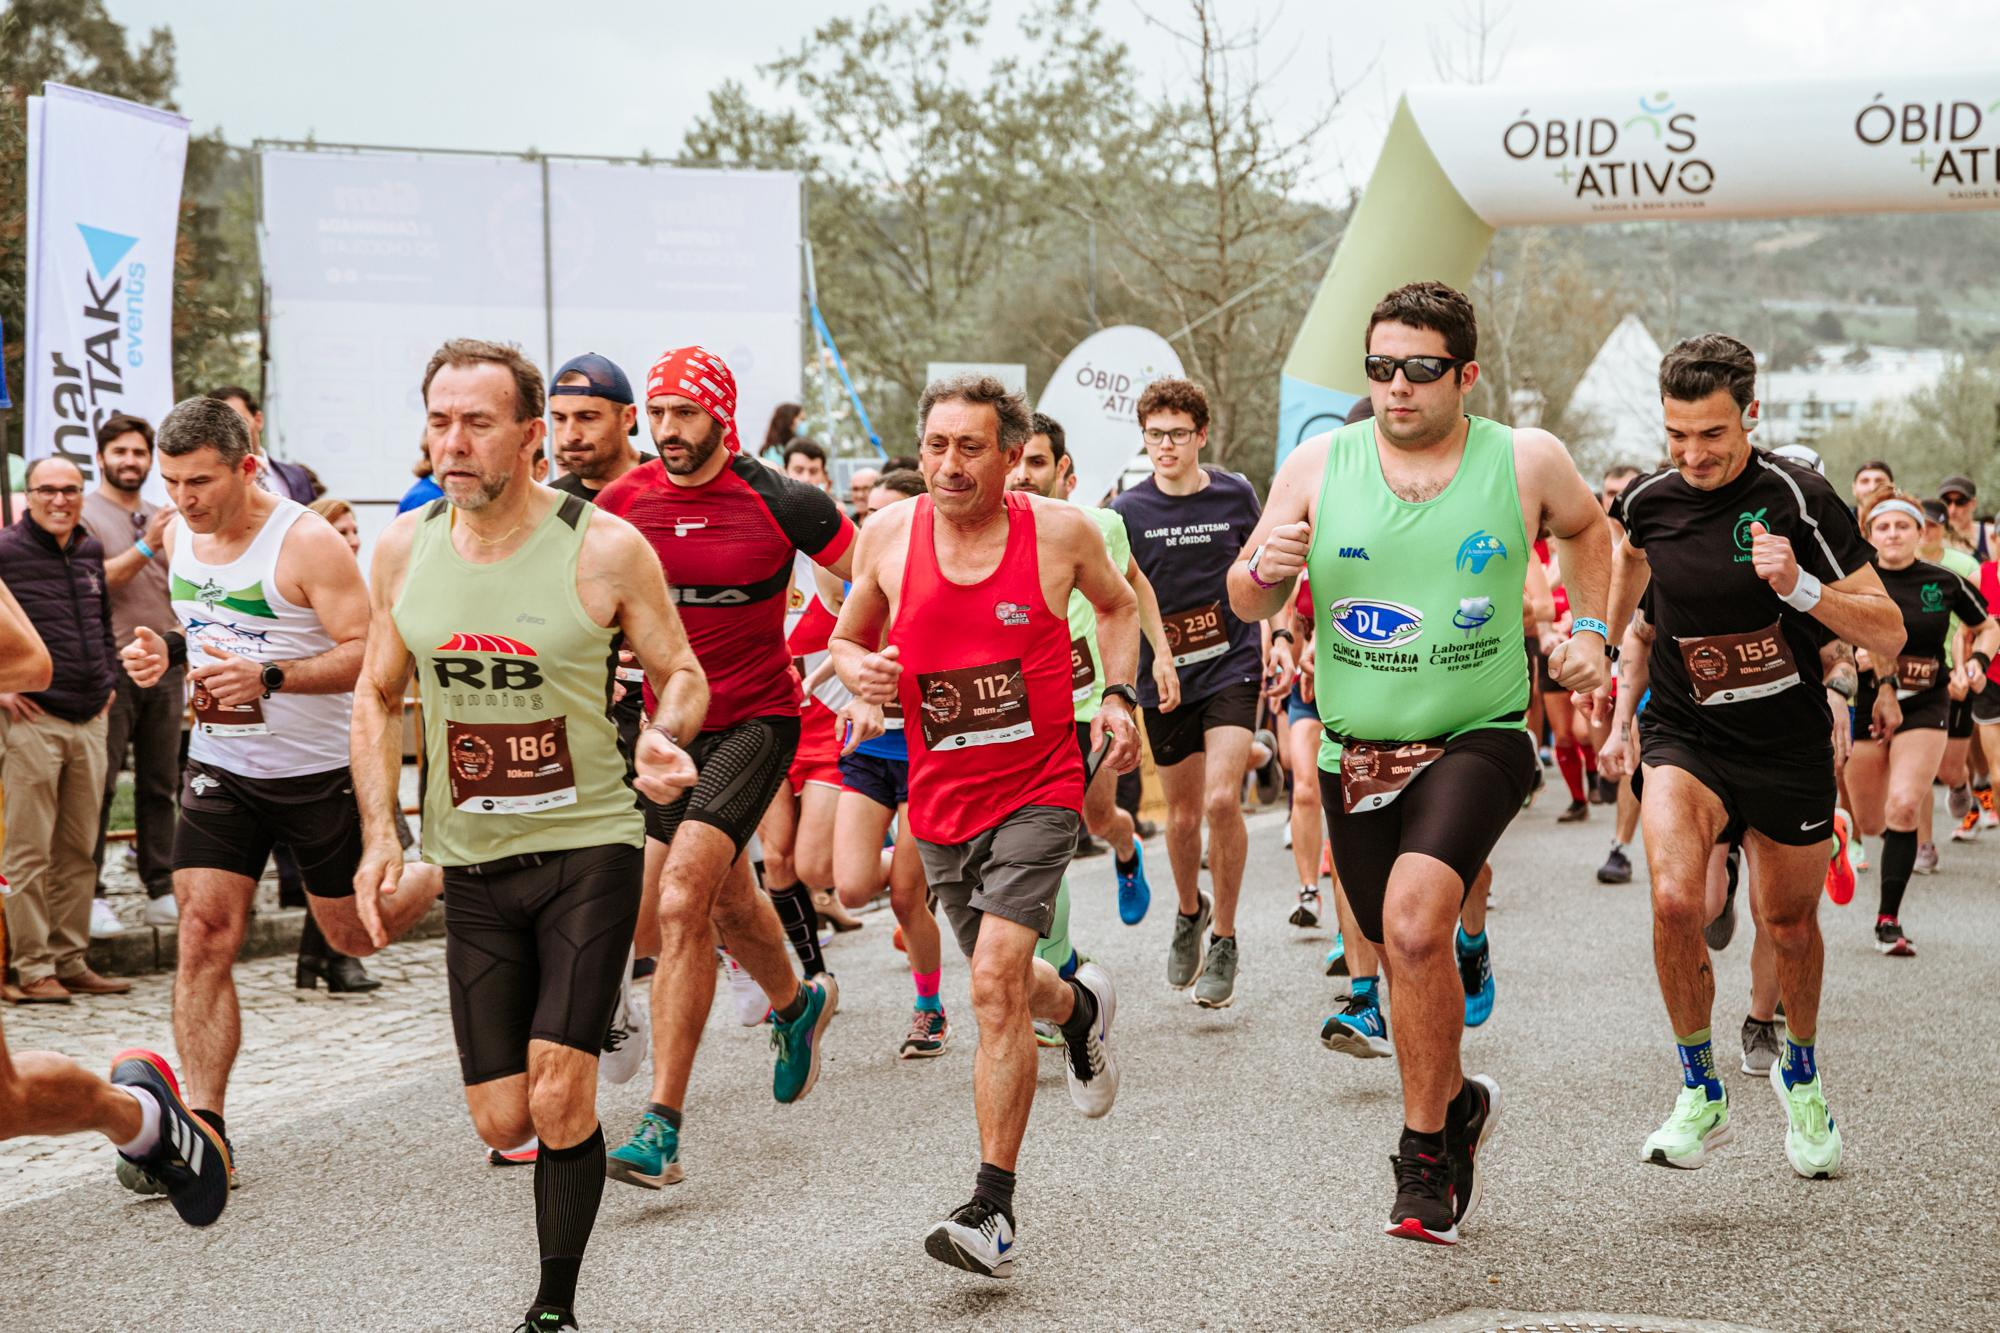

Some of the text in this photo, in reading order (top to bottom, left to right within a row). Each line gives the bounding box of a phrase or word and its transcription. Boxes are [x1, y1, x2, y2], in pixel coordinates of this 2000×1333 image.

[124, 262, 146, 369] events
[1144, 522, 1230, 538] CLUBE DE ATLETISMO
[1166, 534, 1212, 547] DE ÓBIDOS
[668, 588, 751, 604] ILA
[1184, 612, 1218, 634] 230
[1355, 610, 1387, 637] DL
[1333, 642, 1360, 660] CLÍNICA
[1365, 651, 1419, 665] DENTÁRIA
[1432, 636, 1501, 654] Laboratórios
[1734, 637, 1779, 662] 155
[1429, 647, 1498, 665] Carlos Lima
[432, 657, 544, 690] RB
[1740, 666, 1761, 675] 10km
[1907, 662, 1930, 678] 176
[973, 674, 1012, 700] 112
[973, 707, 996, 717] 10km
[506, 732, 556, 761] 186
[506, 769, 534, 778] 10km
[1391, 765, 1413, 775] 10km
